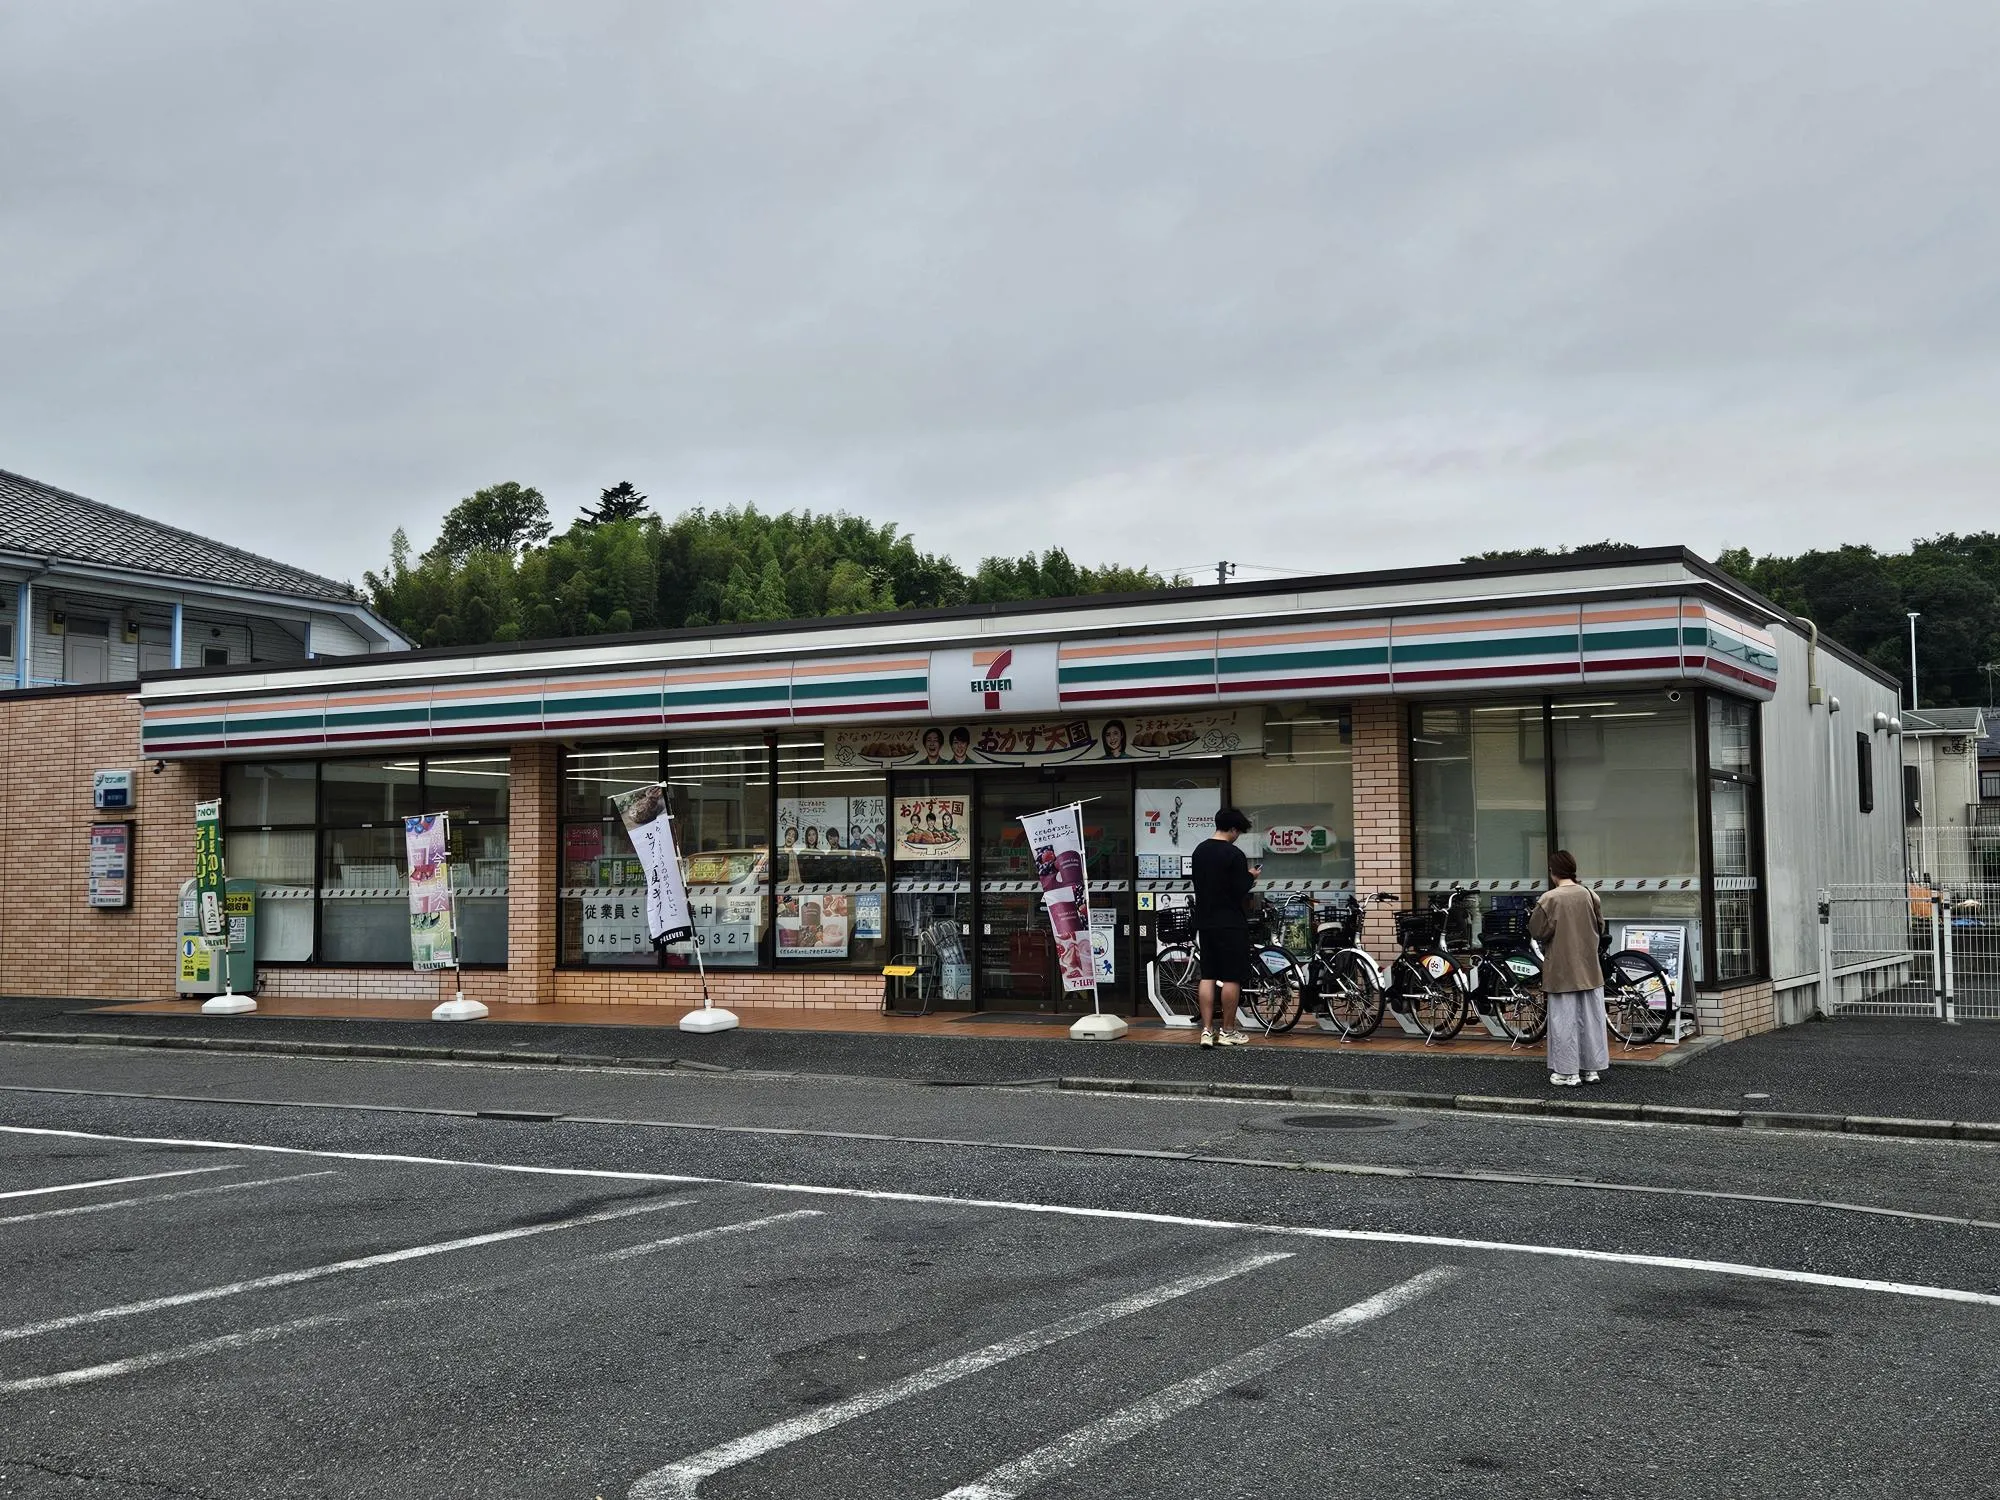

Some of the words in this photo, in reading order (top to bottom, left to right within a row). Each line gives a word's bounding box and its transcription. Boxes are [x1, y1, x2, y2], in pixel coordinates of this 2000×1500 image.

[977, 719, 1090, 752] おかず天国
[900, 797, 964, 818] おかず天国
[1270, 830, 1304, 846] たばこ
